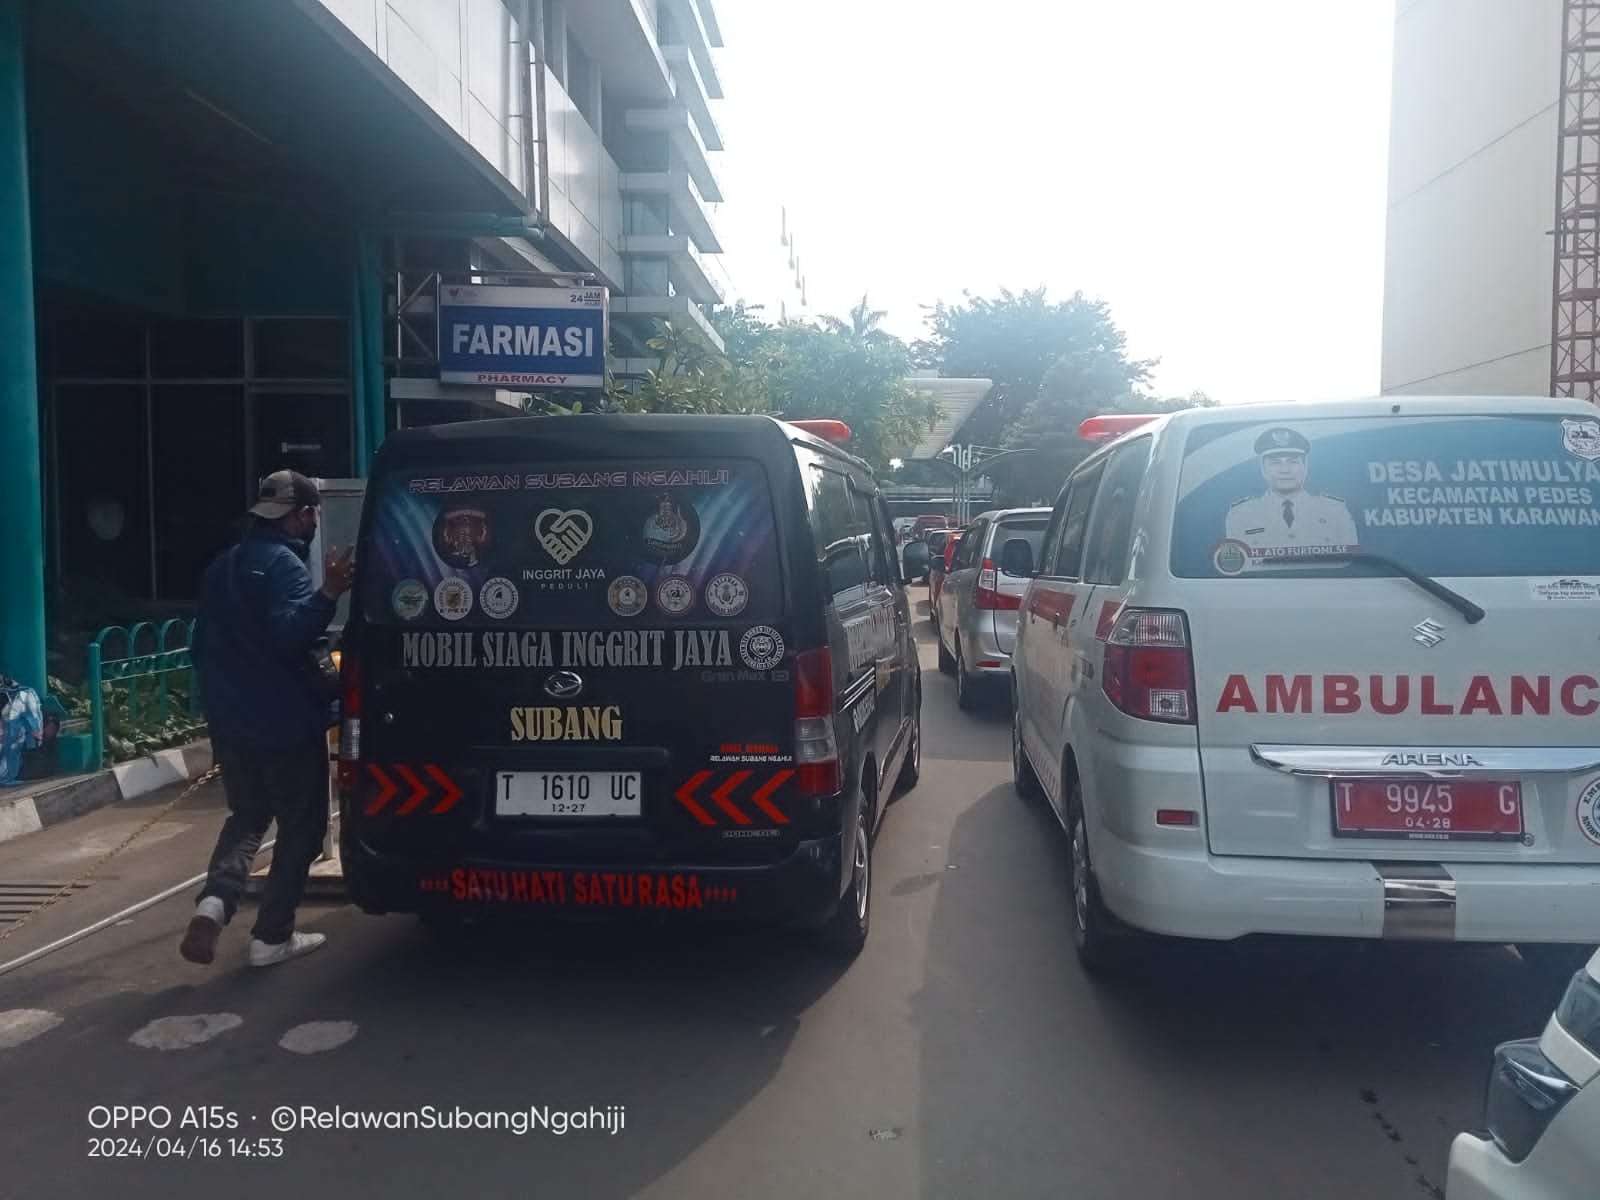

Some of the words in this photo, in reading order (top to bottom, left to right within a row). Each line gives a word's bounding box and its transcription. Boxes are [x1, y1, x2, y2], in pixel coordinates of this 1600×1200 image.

[570, 294, 583, 303] 24
[452, 323, 593, 357] FARMASI
[477, 373, 568, 384] PHARMACY
[409, 474, 520, 494] RELAWAN
[525, 471, 627, 490] SUBANG
[1367, 461, 1443, 483] DESA
[1451, 460, 1600, 483] JATIMULYA
[1387, 487, 1519, 504] KECAMATAN
[1526, 487, 1593, 504] PEDES
[1364, 507, 1493, 526] KABUPATEN
[522, 568, 573, 580] INGGRIT
[575, 568, 606, 580] JAYA
[402, 631, 477, 668] MOBIL
[482, 631, 554, 668] SIAGA
[561, 630, 665, 668] INGGRIT
[672, 630, 733, 671] JAYA
[1215, 674, 1600, 717] AMBULANC
[510, 705, 624, 741] SUBANG
[1381, 752, 1484, 767] ARENA
[502, 774, 514, 801] T
[541, 774, 590, 801] 1610
[610, 774, 637, 801] UC
[1340, 783, 1353, 812] T
[1386, 783, 1453, 814] 9945
[1499, 785, 1516, 815] G
[452, 867, 507, 901] SATU
[512, 870, 565, 903] HATI
[574, 871, 633, 906] SATU
[638, 873, 703, 910] RASA
